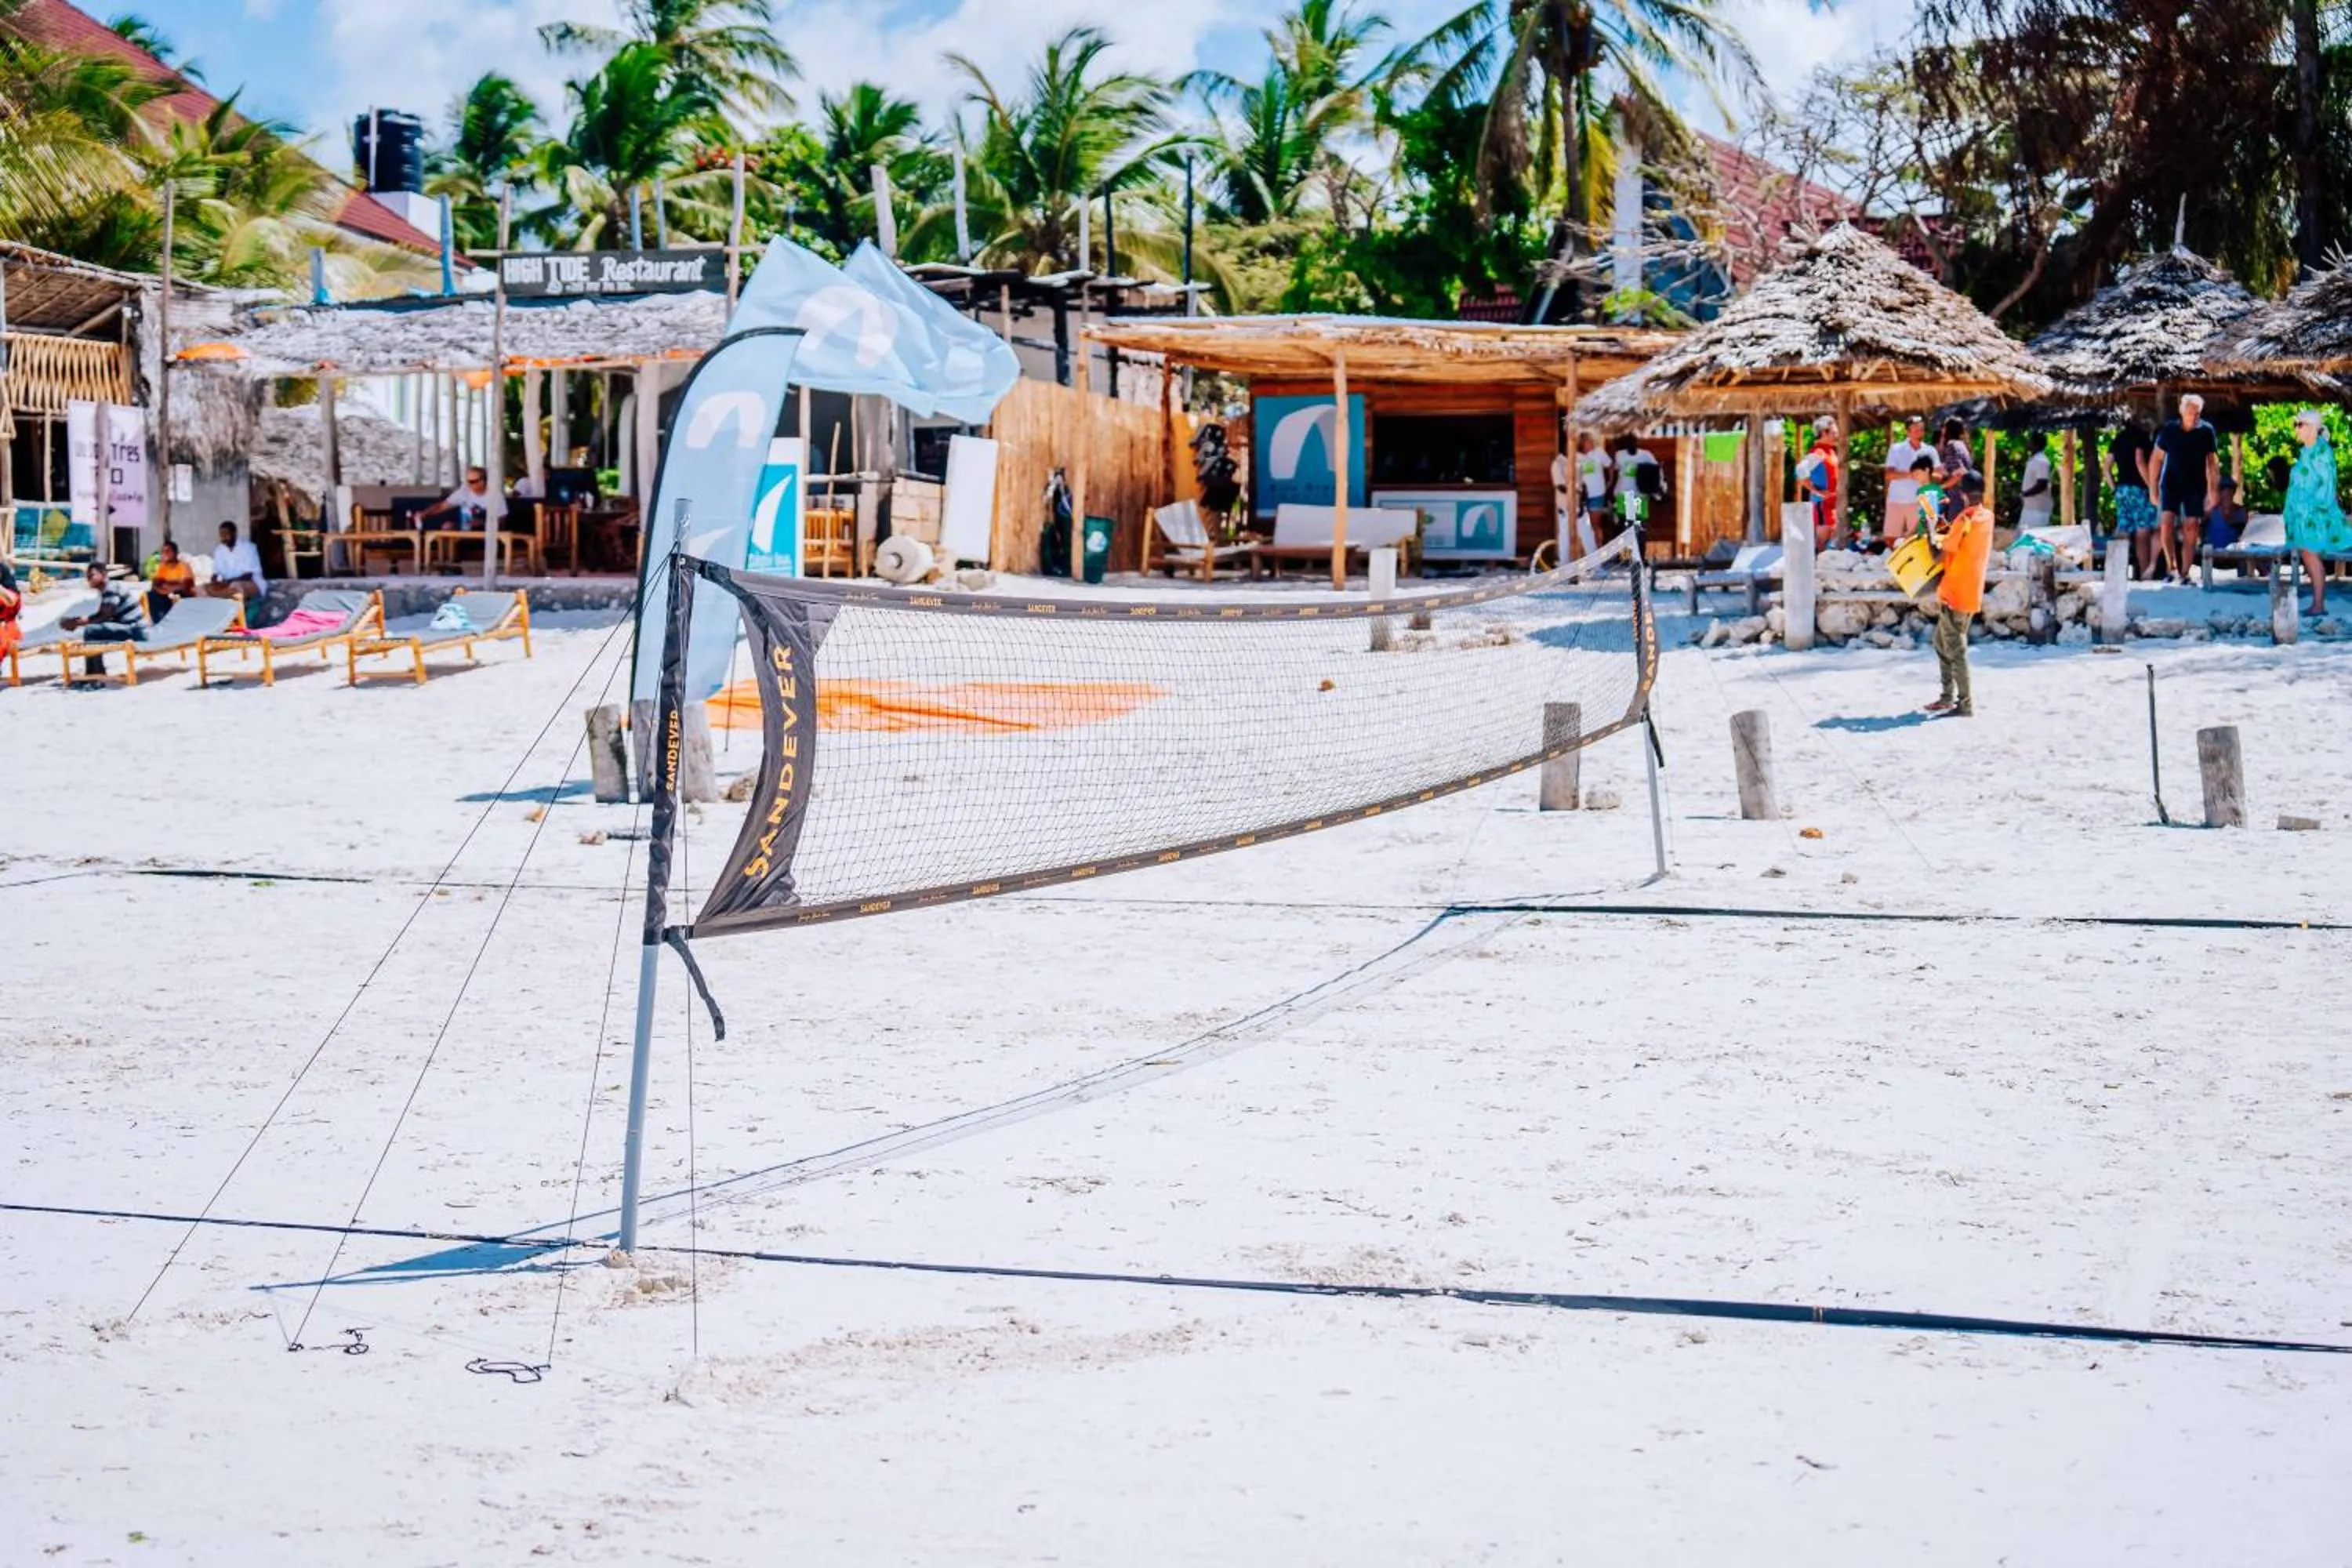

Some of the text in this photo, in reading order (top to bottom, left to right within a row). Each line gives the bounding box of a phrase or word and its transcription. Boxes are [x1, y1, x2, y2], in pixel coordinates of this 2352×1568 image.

[503, 257, 543, 283] HIGH
[598, 255, 707, 281] Restaurant
[666, 710, 680, 791] SANDEVER
[744, 644, 797, 879] SANDEVER
